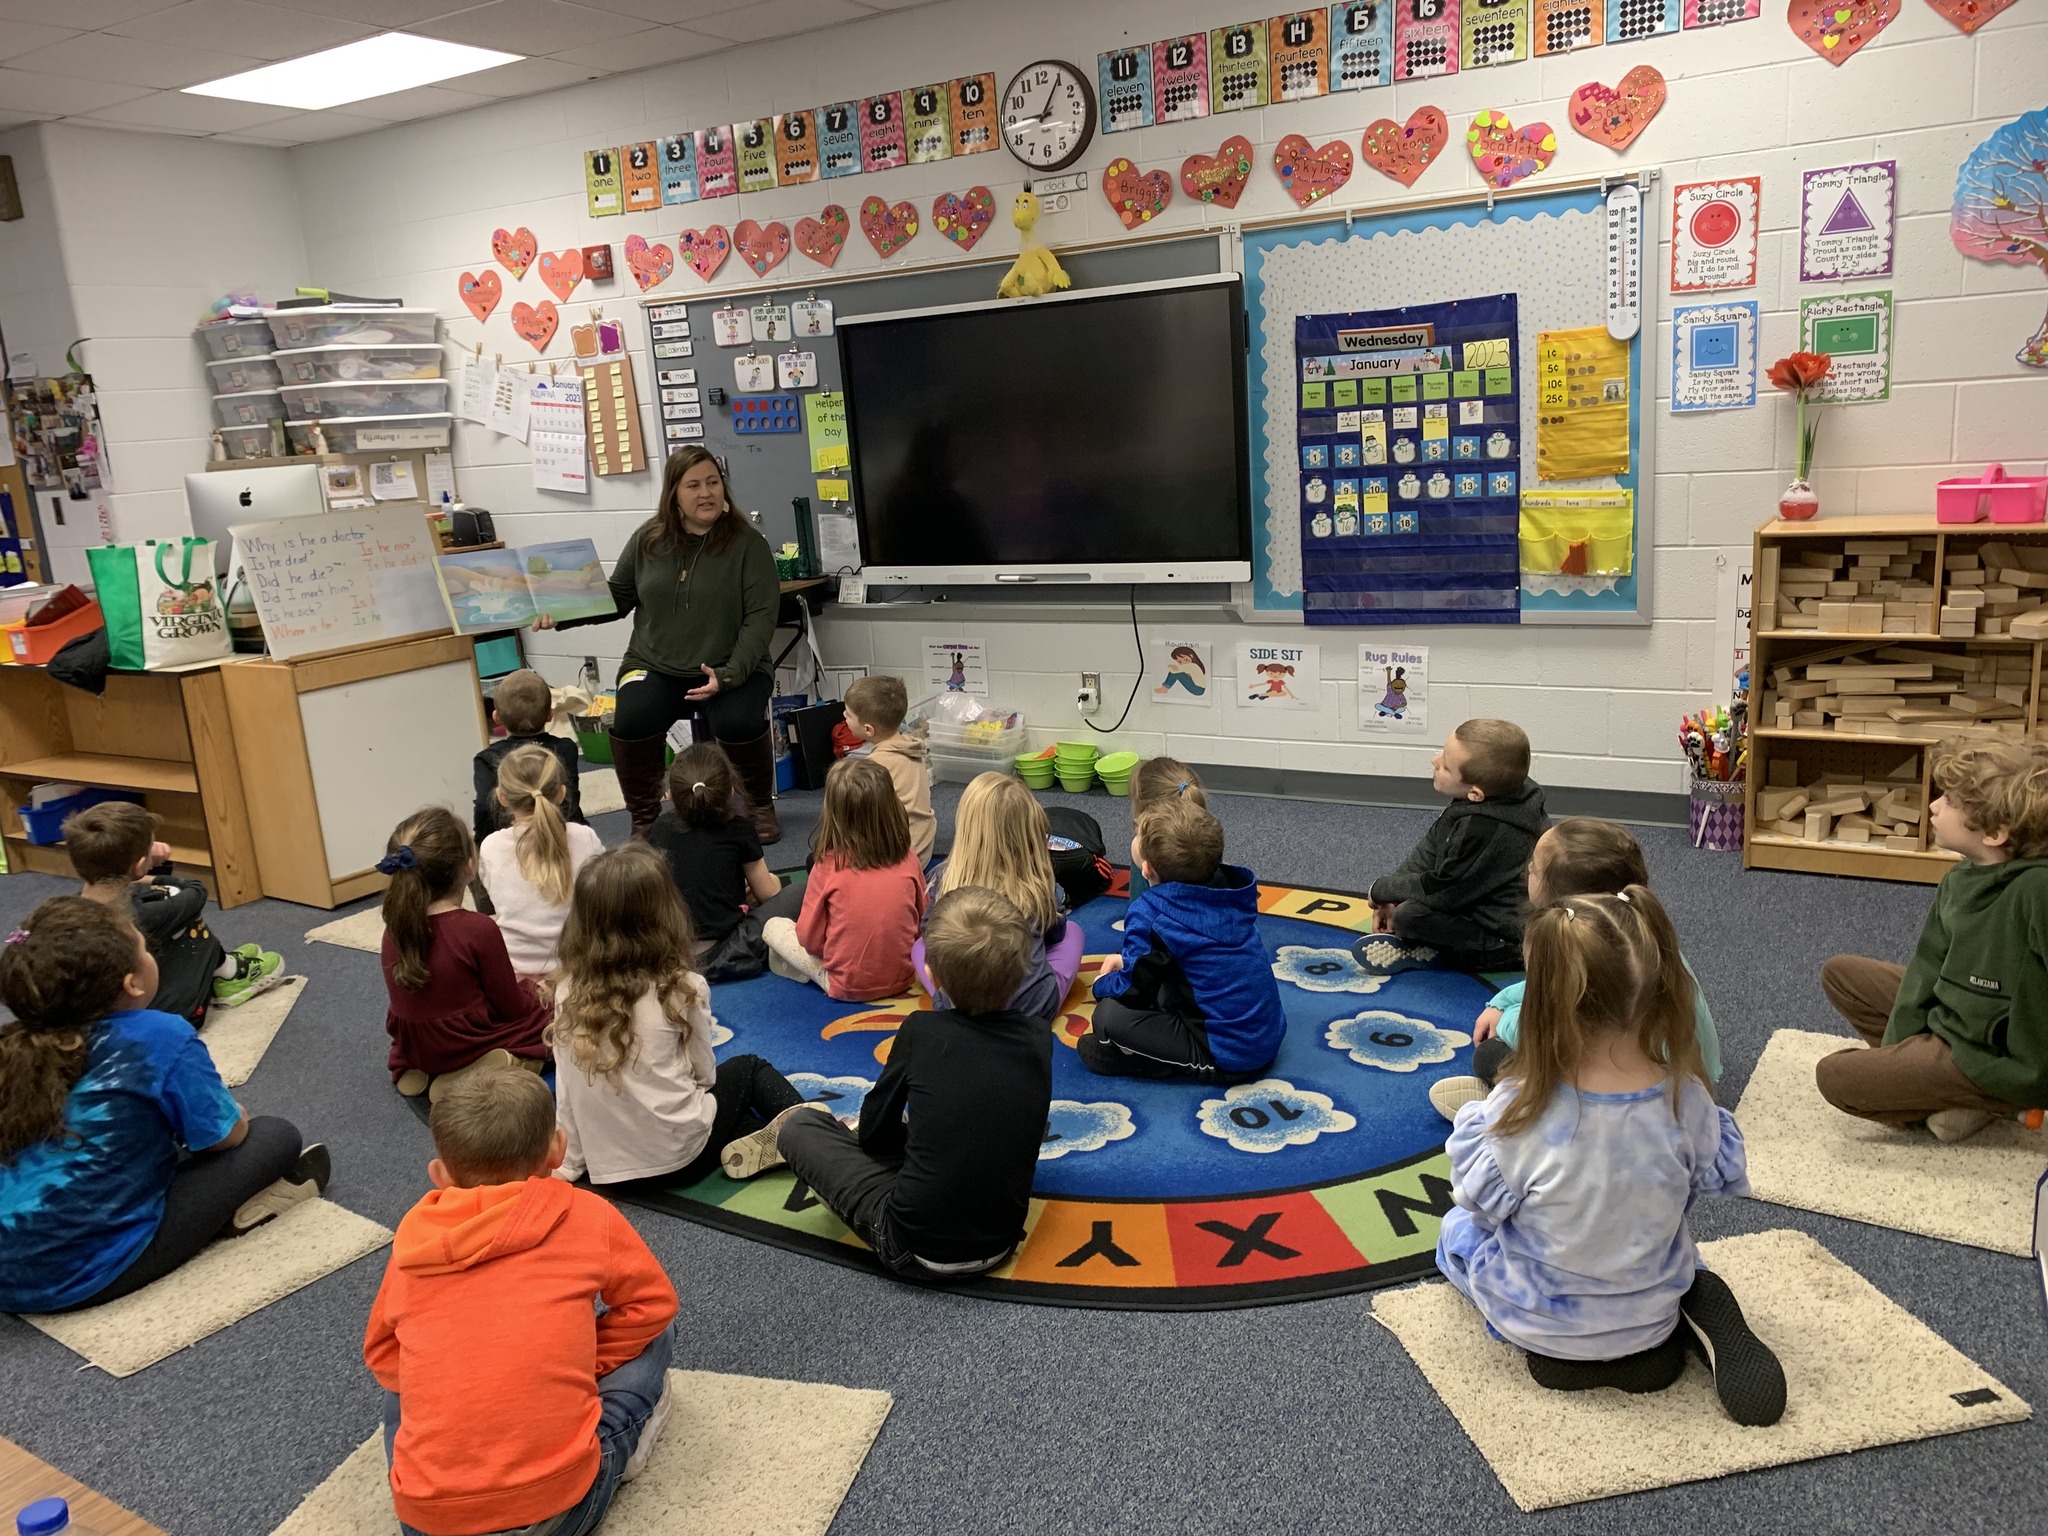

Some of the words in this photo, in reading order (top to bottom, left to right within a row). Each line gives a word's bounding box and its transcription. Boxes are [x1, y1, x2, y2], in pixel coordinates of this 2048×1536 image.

[1419, 0, 1436, 18] 16
[1354, 9, 1369, 31] 15
[1465, 7, 1524, 27] seventeen
[1290, 22, 1306, 42] 14
[1404, 23, 1451, 39] sixteen
[1232, 35, 1246, 54] 13
[1339, 34, 1384, 50] fifteen
[1173, 47, 1188, 66] 12
[1274, 46, 1323, 64] fourteen
[1118, 60, 1130, 76] 11
[1219, 58, 1260, 74] thirteen
[1035, 70, 1049, 86] 12
[1162, 71, 1200, 86] twelve
[1021, 78, 1032, 94] 11
[1066, 84, 1075, 98] 2
[1107, 81, 1145, 96] eleven
[965, 85, 979, 102] 10
[921, 95, 930, 111] 9
[1011, 95, 1025, 110] 10
[1072, 101, 1081, 115] 3
[875, 104, 885, 120] 8
[962, 108, 985, 121] ten
[831, 112, 841, 128] 7
[914, 116, 940, 128] nine
[1008, 115, 1017, 126] 9
[790, 121, 800, 136] 6
[869, 124, 896, 139] eight
[709, 135, 718, 150] 4
[749, 129, 758, 144] 5
[824, 132, 854, 146] seven
[1015, 135, 1024, 146] 8
[1058, 136, 1067, 150] 5
[671, 143, 680, 159] 3
[788, 140, 806, 154] six
[1028, 142, 1036, 156] 7
[1043, 144, 1052, 158] 6
[1385, 133, 1437, 155] Eleanor
[1480, 135, 1542, 155] Scarlett
[634, 152, 643, 167] 2
[704, 156, 727, 169] four
[743, 149, 766, 162] five
[665, 163, 692, 175] three
[1293, 157, 1338, 179] Skylar
[593, 177, 613, 187] one
[631, 171, 651, 182] two
[1810, 180, 1843, 189] Tommy
[1846, 173, 1887, 185] Triangle
[1043, 179, 1068, 192] clock
[1120, 181, 1157, 200] Briggs
[1690, 193, 1713, 201] Suzy
[1715, 188, 1744, 199] Circle
[1609, 209, 1618, 217] 120
[1609, 221, 1618, 229] 100
[750, 238, 773, 249] Davis
[1815, 239, 1843, 247] Tommy
[1845, 234, 1879, 244] Triangle
[1693, 250, 1712, 258] Suzy
[1713, 248, 1735, 256] Circle
[1813, 246, 1837, 255] Proud
[1687, 259, 1699, 267] Big
[1700, 257, 1714, 265] and
[1815, 254, 1840, 263] Count
[1698, 272, 1727, 281] around!
[1807, 306, 1833, 316] Ricky
[1836, 302, 1883, 313] Rectangle
[1683, 314, 1711, 324] Sandy
[1714, 312, 1748, 322] Square
[1344, 333, 1424, 349] Wednesday
[667, 346, 689, 354] calendar
[1465, 341, 1510, 369] 2023
[1547, 350, 1557, 359] 1¢
[1350, 358, 1401, 371] January
[1547, 364, 1559, 374] 5¢
[1837, 361, 1877, 370] Rectangle
[1713, 369, 1740, 377] Square
[1857, 369, 1883, 377] wrong.
[552, 380, 580, 392] January
[1547, 379, 1563, 389] 10¢
[565, 393, 581, 403] 2023
[815, 399, 843, 409] Helper
[1545, 394, 1564, 404] 25¢
[817, 413, 828, 423] of
[830, 413, 846, 422] the
[680, 426, 700, 434] reading
[824, 428, 842, 438] Day
[820, 454, 846, 467] Eloise
[1370, 485, 1380, 493] 10
[1462, 482, 1473, 491] 13
[1497, 480, 1507, 489] 14
[1372, 520, 1382, 528] 17
[1400, 519, 1411, 528] 18
[242, 537, 276, 555] Why
[284, 540, 295, 549] is
[299, 532, 317, 546] he
[320, 536, 327, 544] a
[248, 556, 265, 571] Is
[267, 555, 281, 569] he
[257, 572, 279, 588] Did
[288, 570, 303, 584] he
[149, 608, 222, 627] VIRGINIA
[1737, 610, 1751, 618] Dd
[157, 622, 221, 639] GROWN
[1165, 641, 1199, 649] Mountain
[1250, 648, 1278, 660] SIDE
[1281, 650, 1303, 661] SIT
[1365, 651, 1387, 664] Rug
[1392, 652, 1422, 664] Rules
[1297, 899, 1350, 914] P
[1305, 961, 1343, 976] 8
[1369, 1031, 1414, 1047] 9
[1229, 1100, 1305, 1129] 10
[1055, 1221, 1141, 1267] Y
[1195, 1212, 1303, 1268] X
